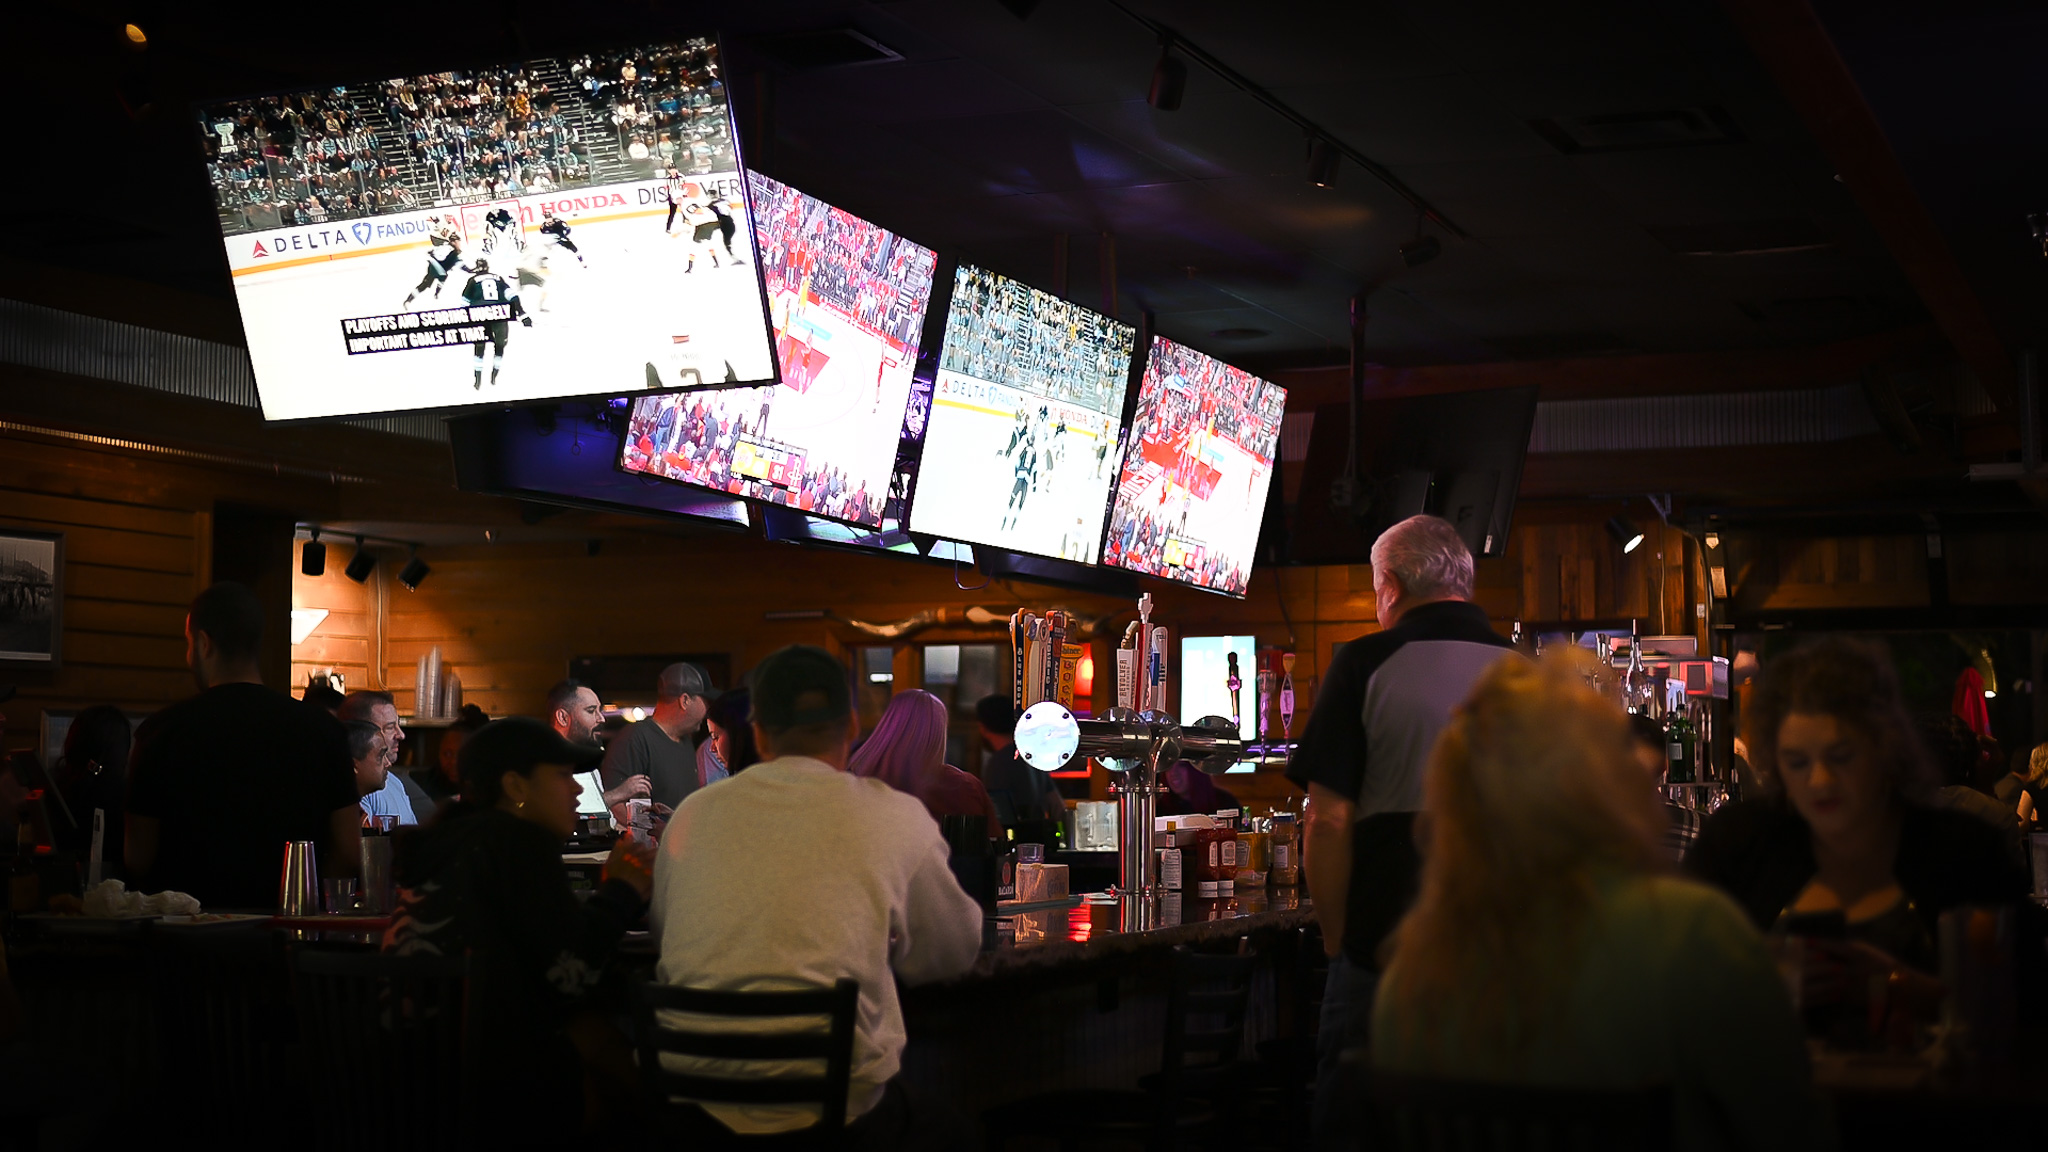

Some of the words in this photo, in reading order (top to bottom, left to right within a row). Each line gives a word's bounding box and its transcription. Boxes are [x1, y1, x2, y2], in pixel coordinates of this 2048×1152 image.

[540, 193, 627, 217] HONDA
[638, 178, 742, 205] DISOVER
[274, 230, 347, 253] DELTA
[377, 219, 430, 239] FANDU
[344, 316, 398, 335] PLAYOFFS
[398, 314, 420, 330] AND
[421, 308, 469, 327] SCORING
[469, 304, 511, 323] HUGELY
[349, 334, 408, 353] IMPORTANT
[409, 331, 444, 348] GOALS
[445, 330, 458, 344] AT
[458, 326, 490, 342] THAT.
[952, 380, 985, 398] DELTA
[1061, 660, 1073, 706] BOCK
[1119, 659, 1127, 697] REVOLVER
